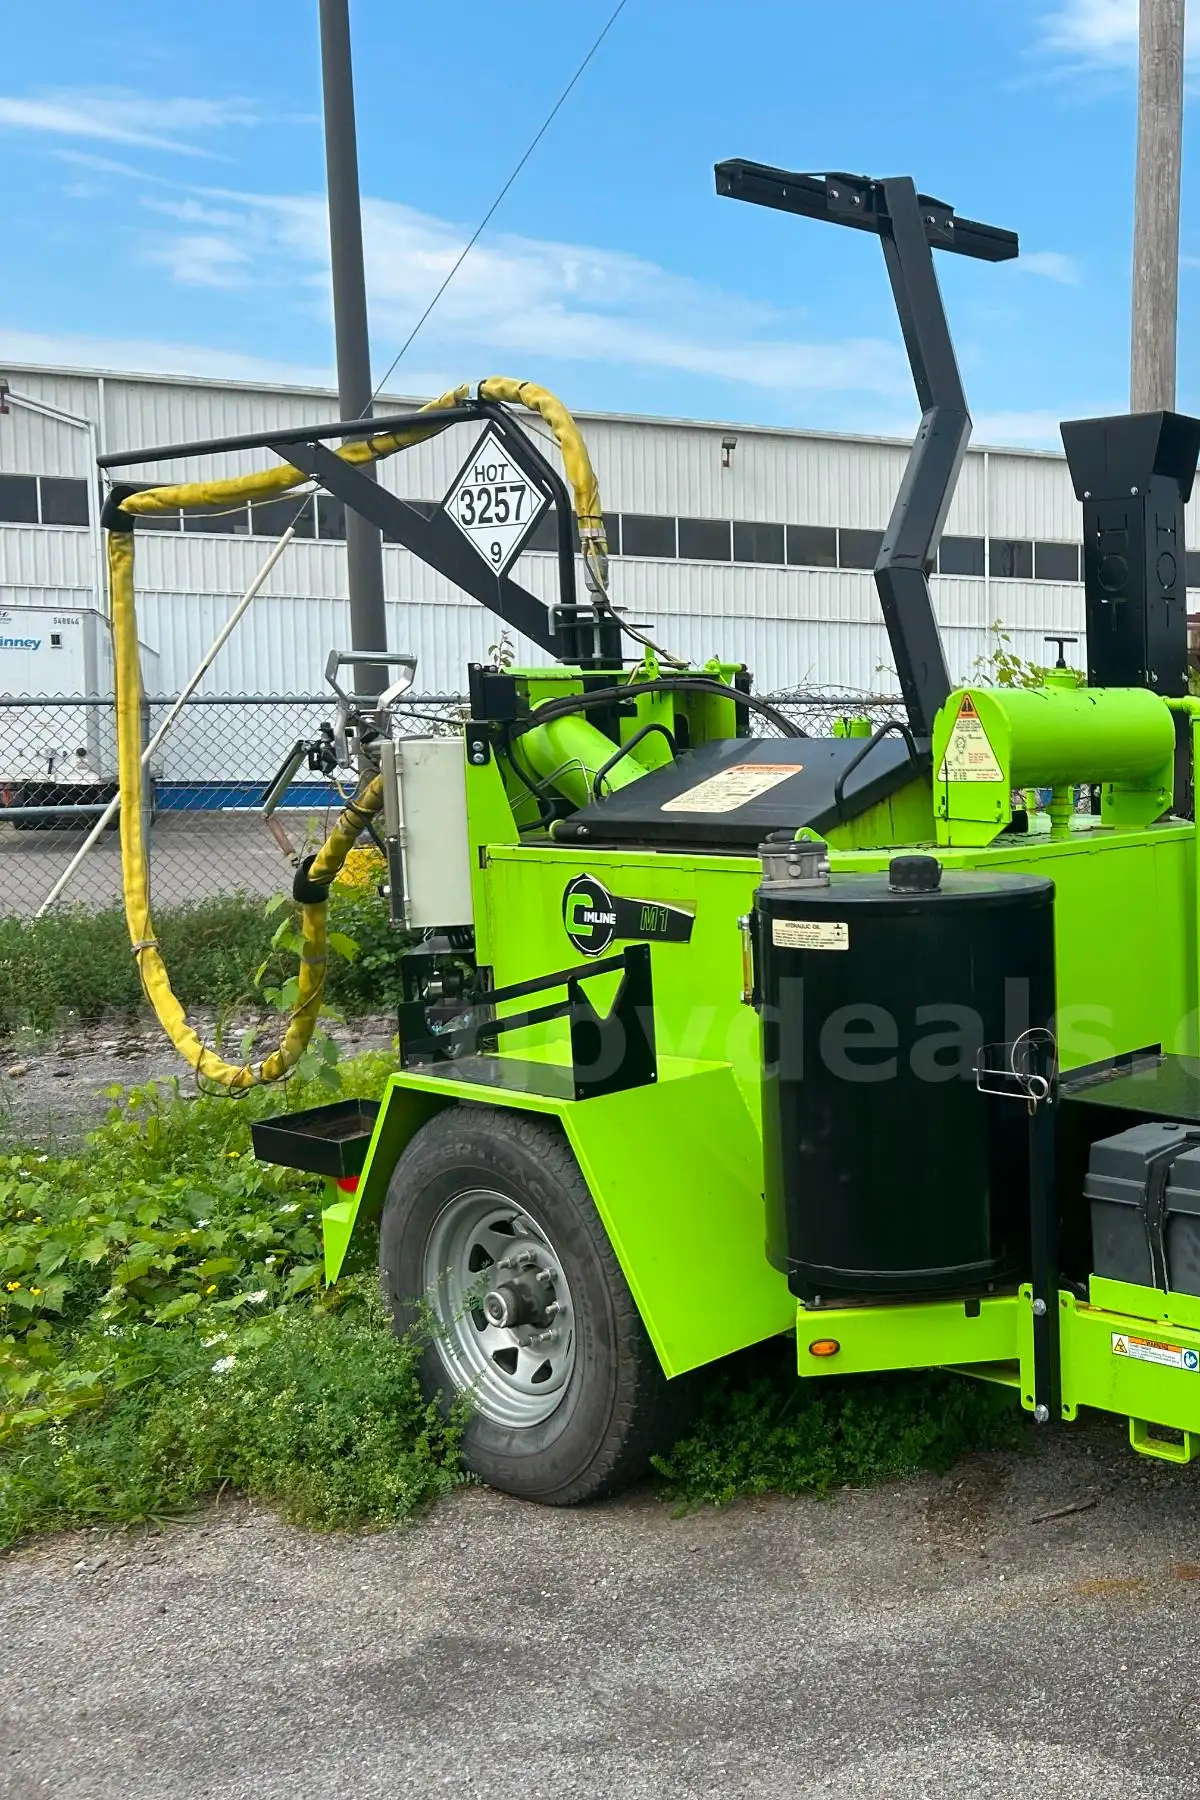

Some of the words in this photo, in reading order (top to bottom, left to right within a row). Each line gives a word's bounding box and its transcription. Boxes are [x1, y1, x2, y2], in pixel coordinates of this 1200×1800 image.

[474, 463, 509, 483] HOT
[459, 484, 526, 526] 3257
[490, 541, 502, 564] 9
[640, 905, 669, 932] M1
